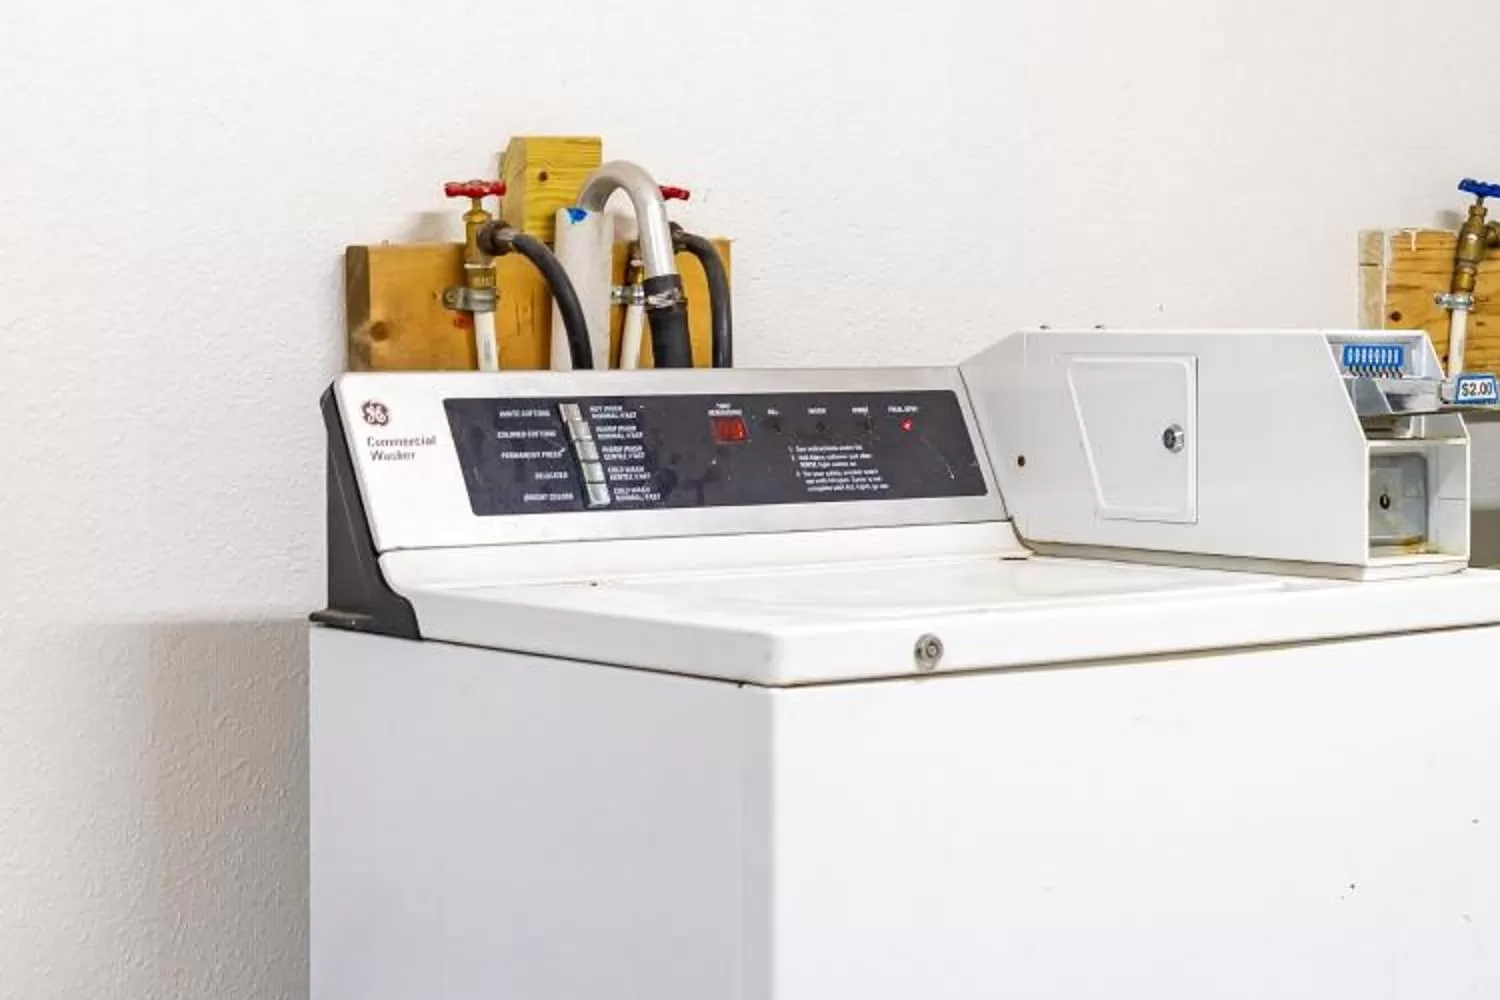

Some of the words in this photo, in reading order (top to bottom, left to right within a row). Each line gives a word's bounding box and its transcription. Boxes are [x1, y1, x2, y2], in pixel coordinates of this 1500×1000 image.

[1461, 383, 1493, 397] $2.00
[366, 435, 437, 448] Commercial
[370, 450, 416, 462] Washer
